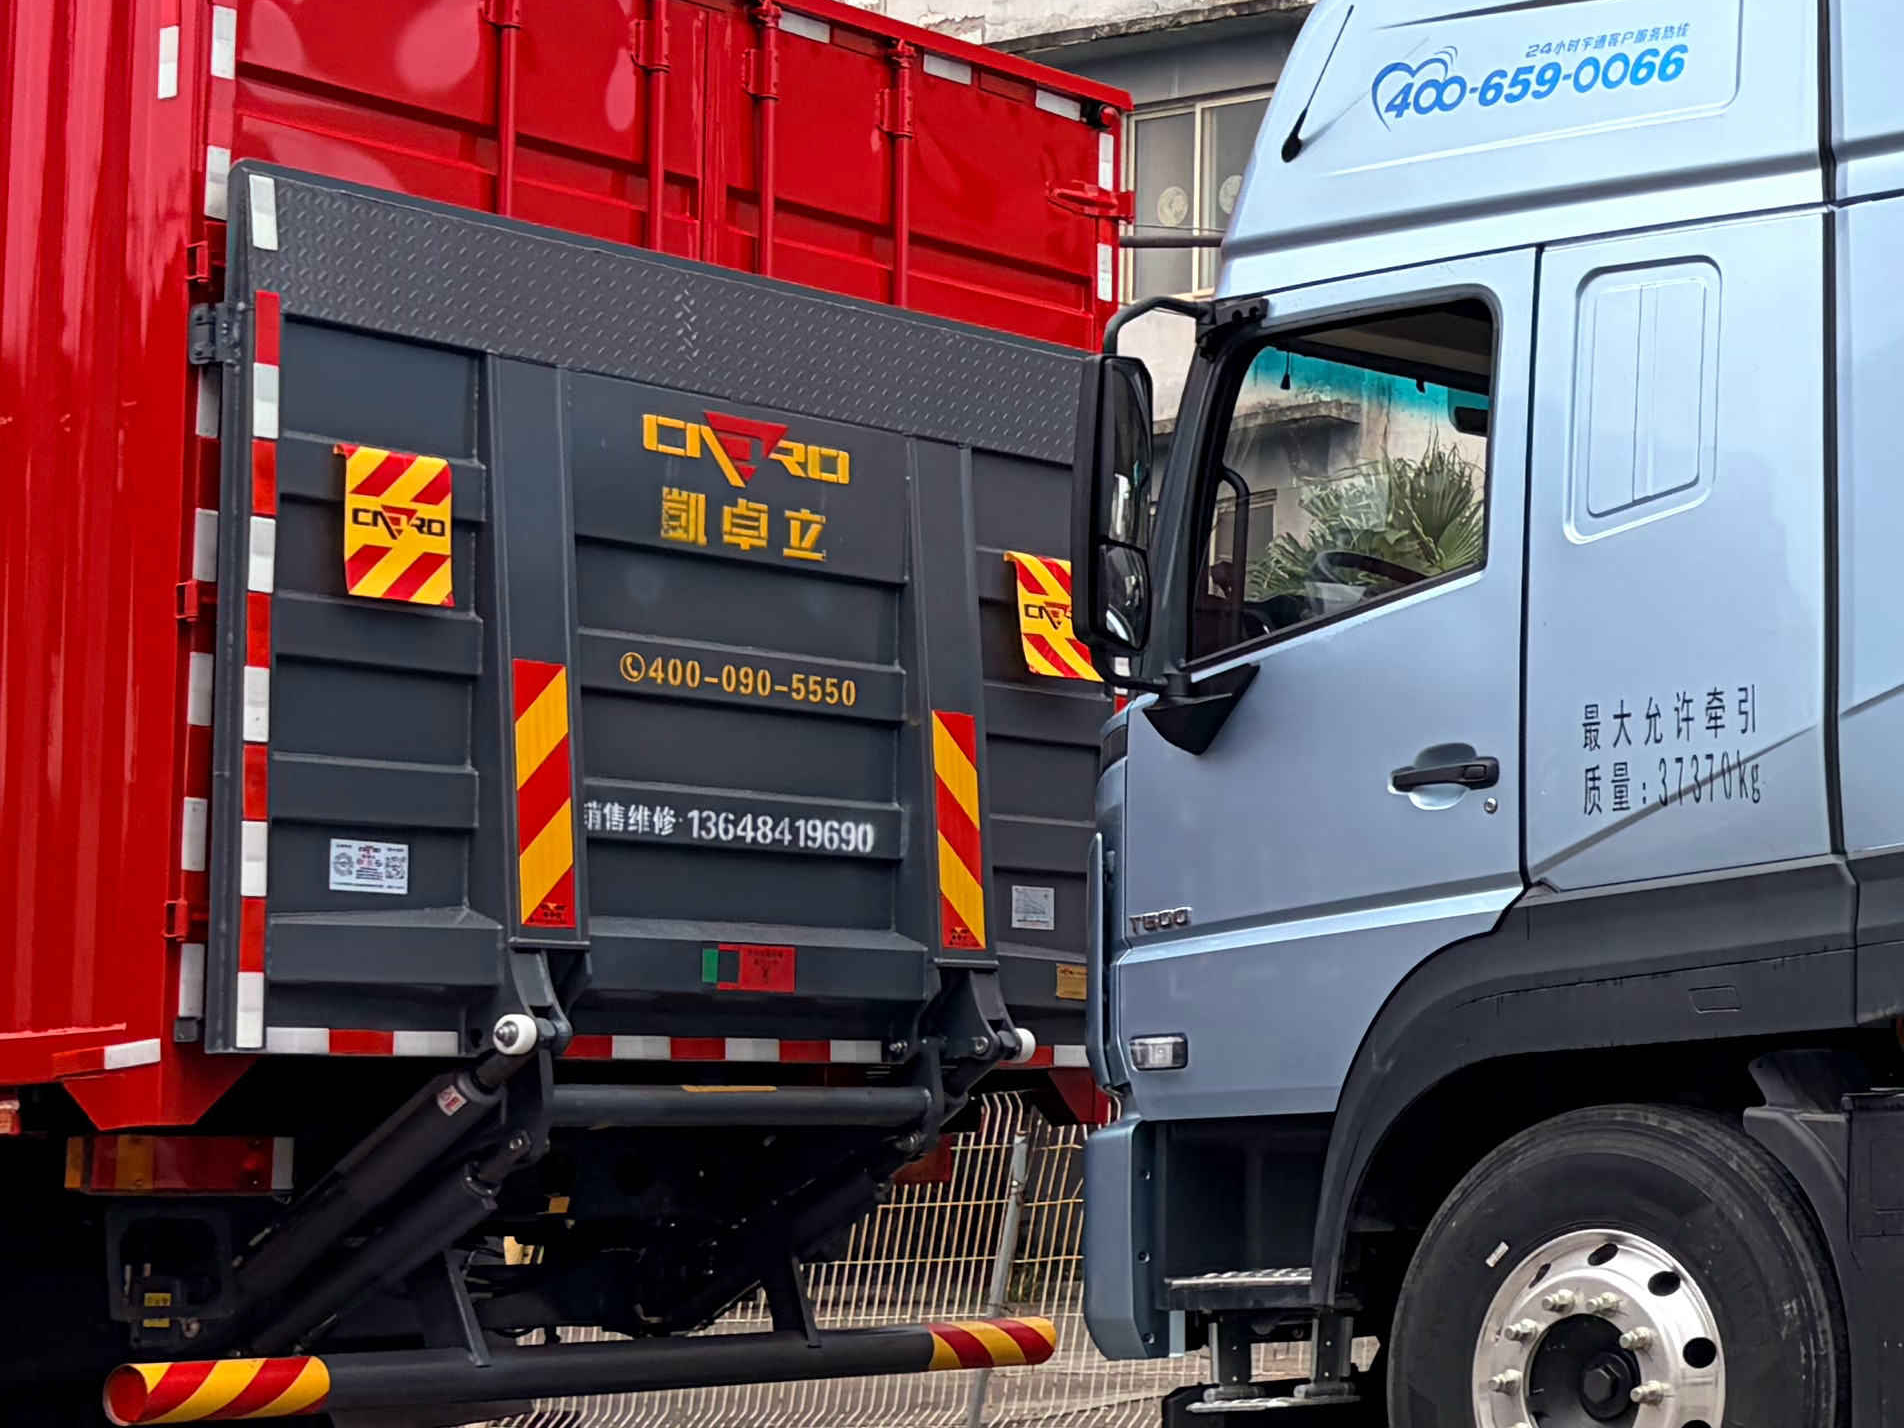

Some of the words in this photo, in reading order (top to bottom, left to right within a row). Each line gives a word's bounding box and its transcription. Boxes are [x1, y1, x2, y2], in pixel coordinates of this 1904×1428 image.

[1384, 44, 1689, 119] 400-659-0066
[648, 657, 856, 707] 400-090-5550
[1582, 684, 1756, 752] 最大允许牵引
[687, 810, 875, 854] 13648419690
